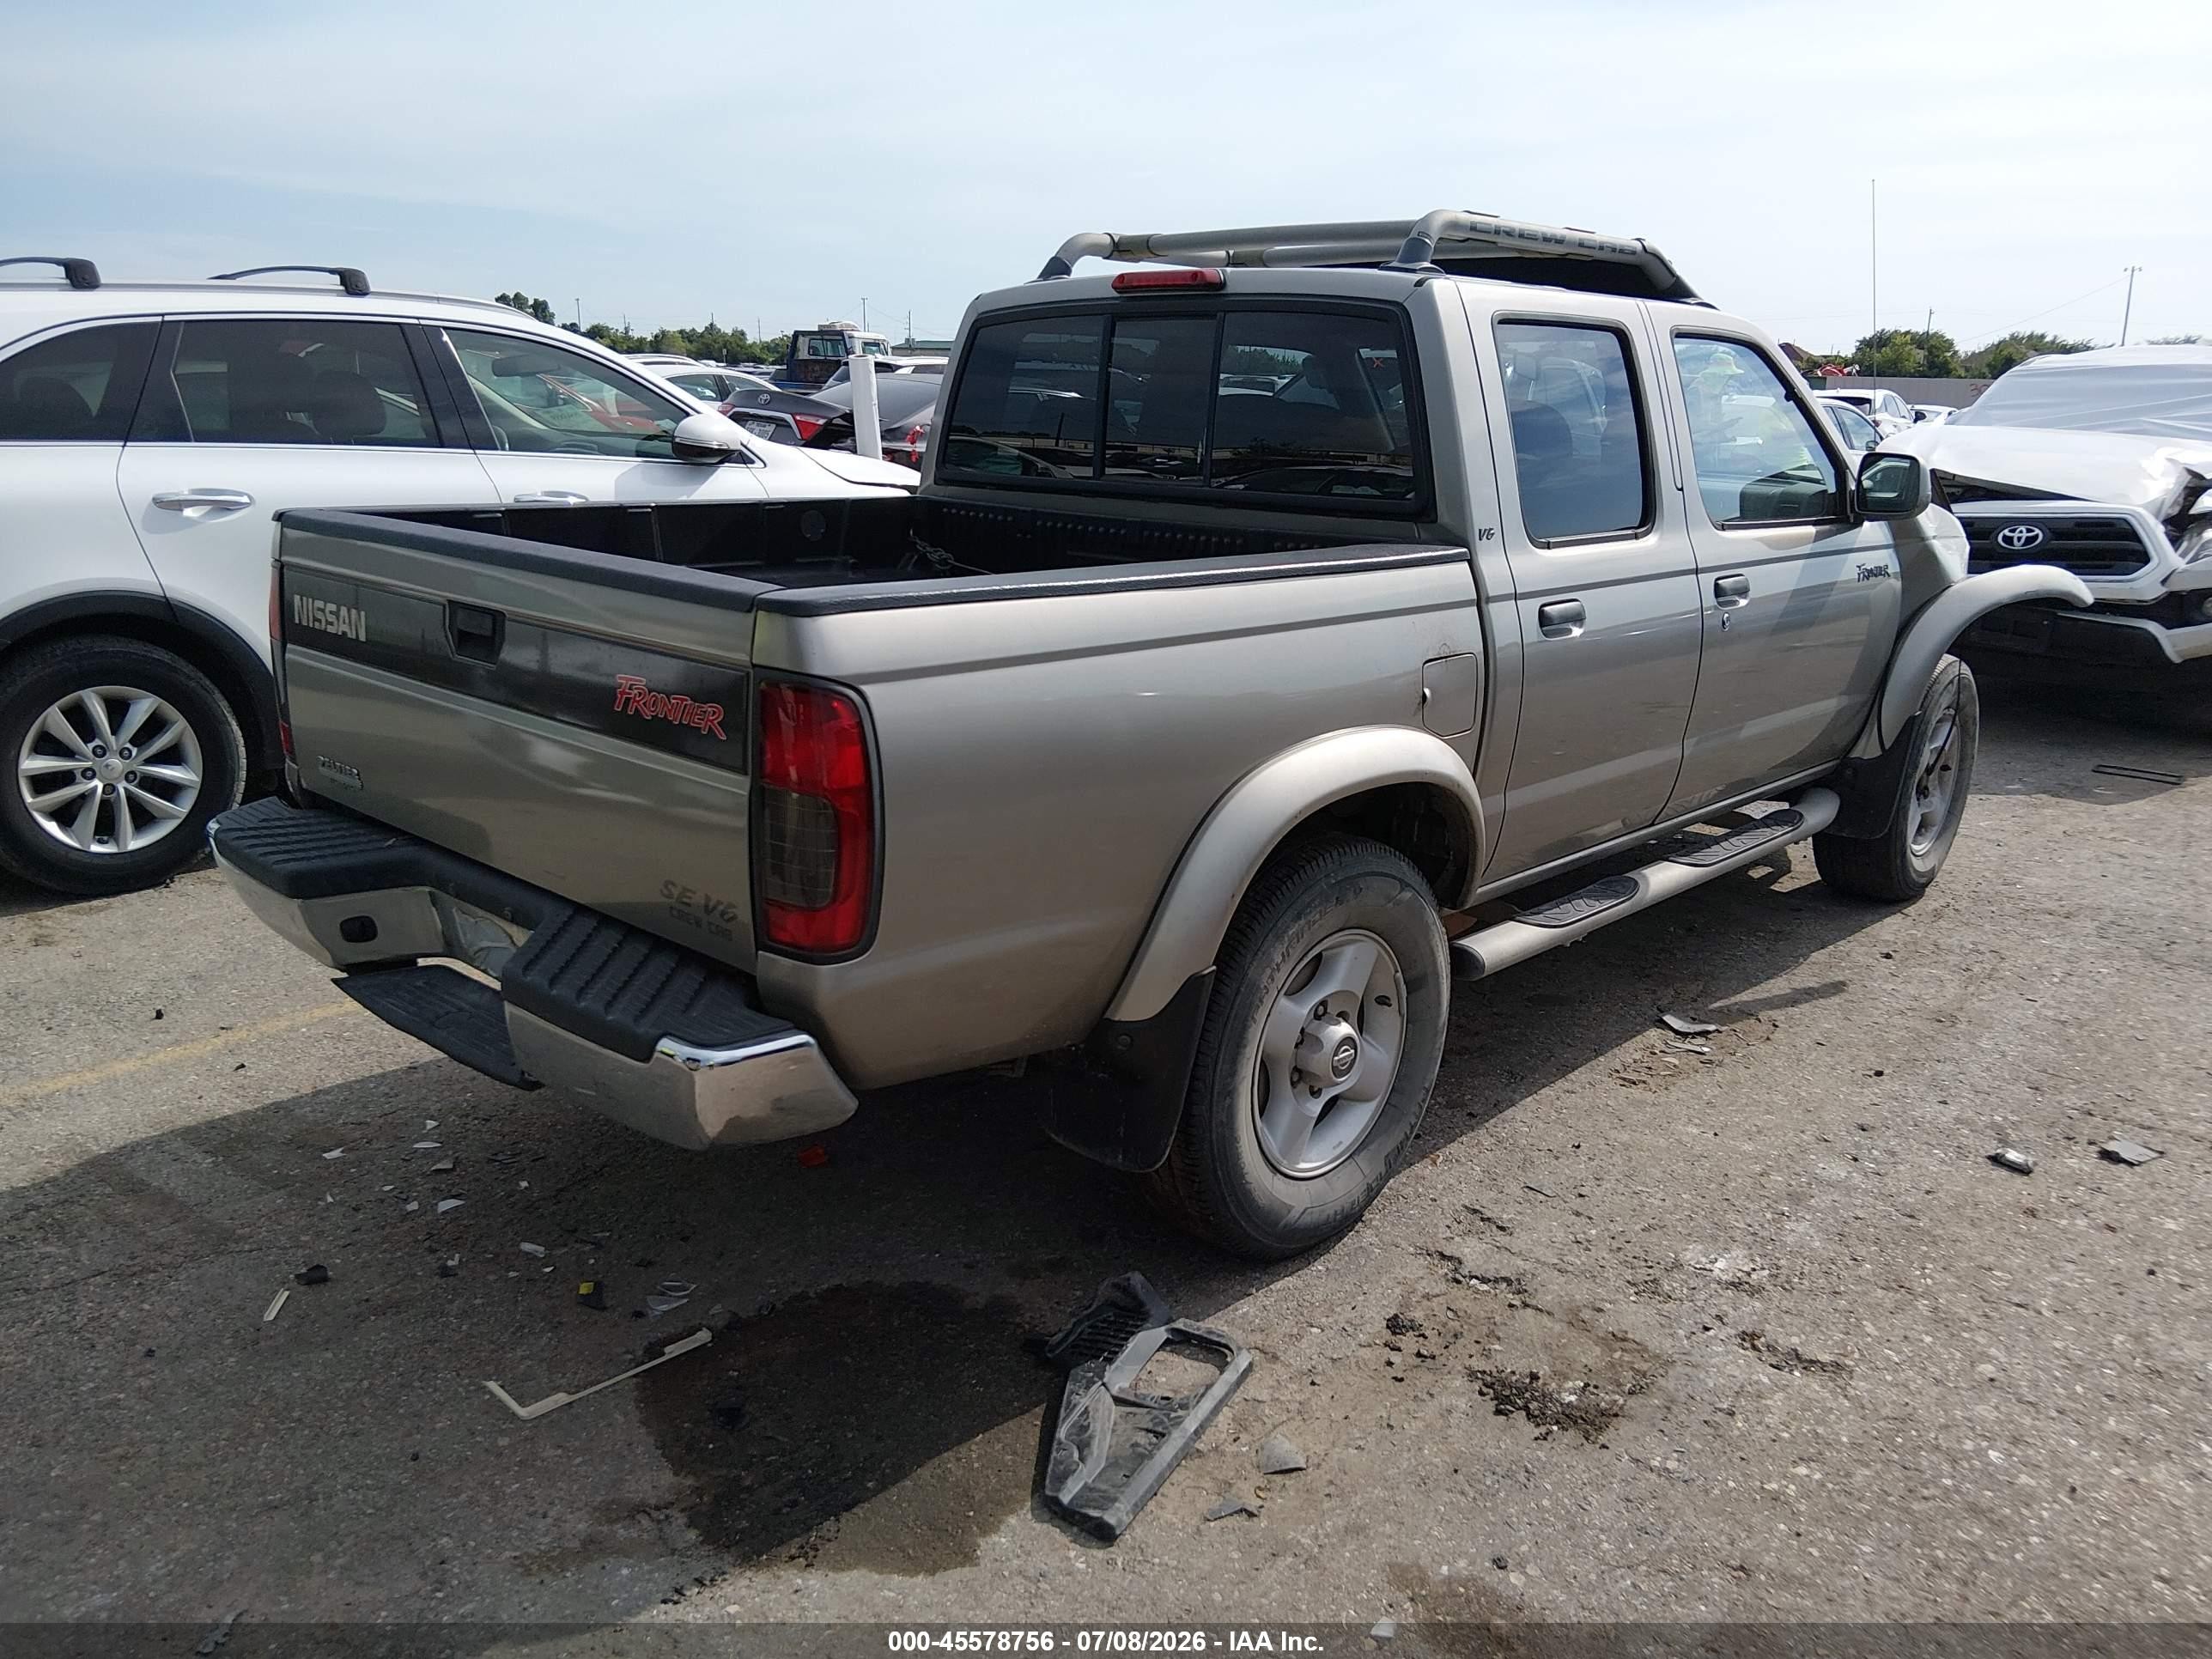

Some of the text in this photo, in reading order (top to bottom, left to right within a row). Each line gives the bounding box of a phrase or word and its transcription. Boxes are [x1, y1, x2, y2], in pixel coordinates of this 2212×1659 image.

[1469, 220, 1638, 256] CREW CAB
[1478, 527, 1495, 542] V6
[293, 593, 368, 643] NISSAN
[615, 673, 728, 741] FRONTIER
[659, 878, 738, 923] SE V6
